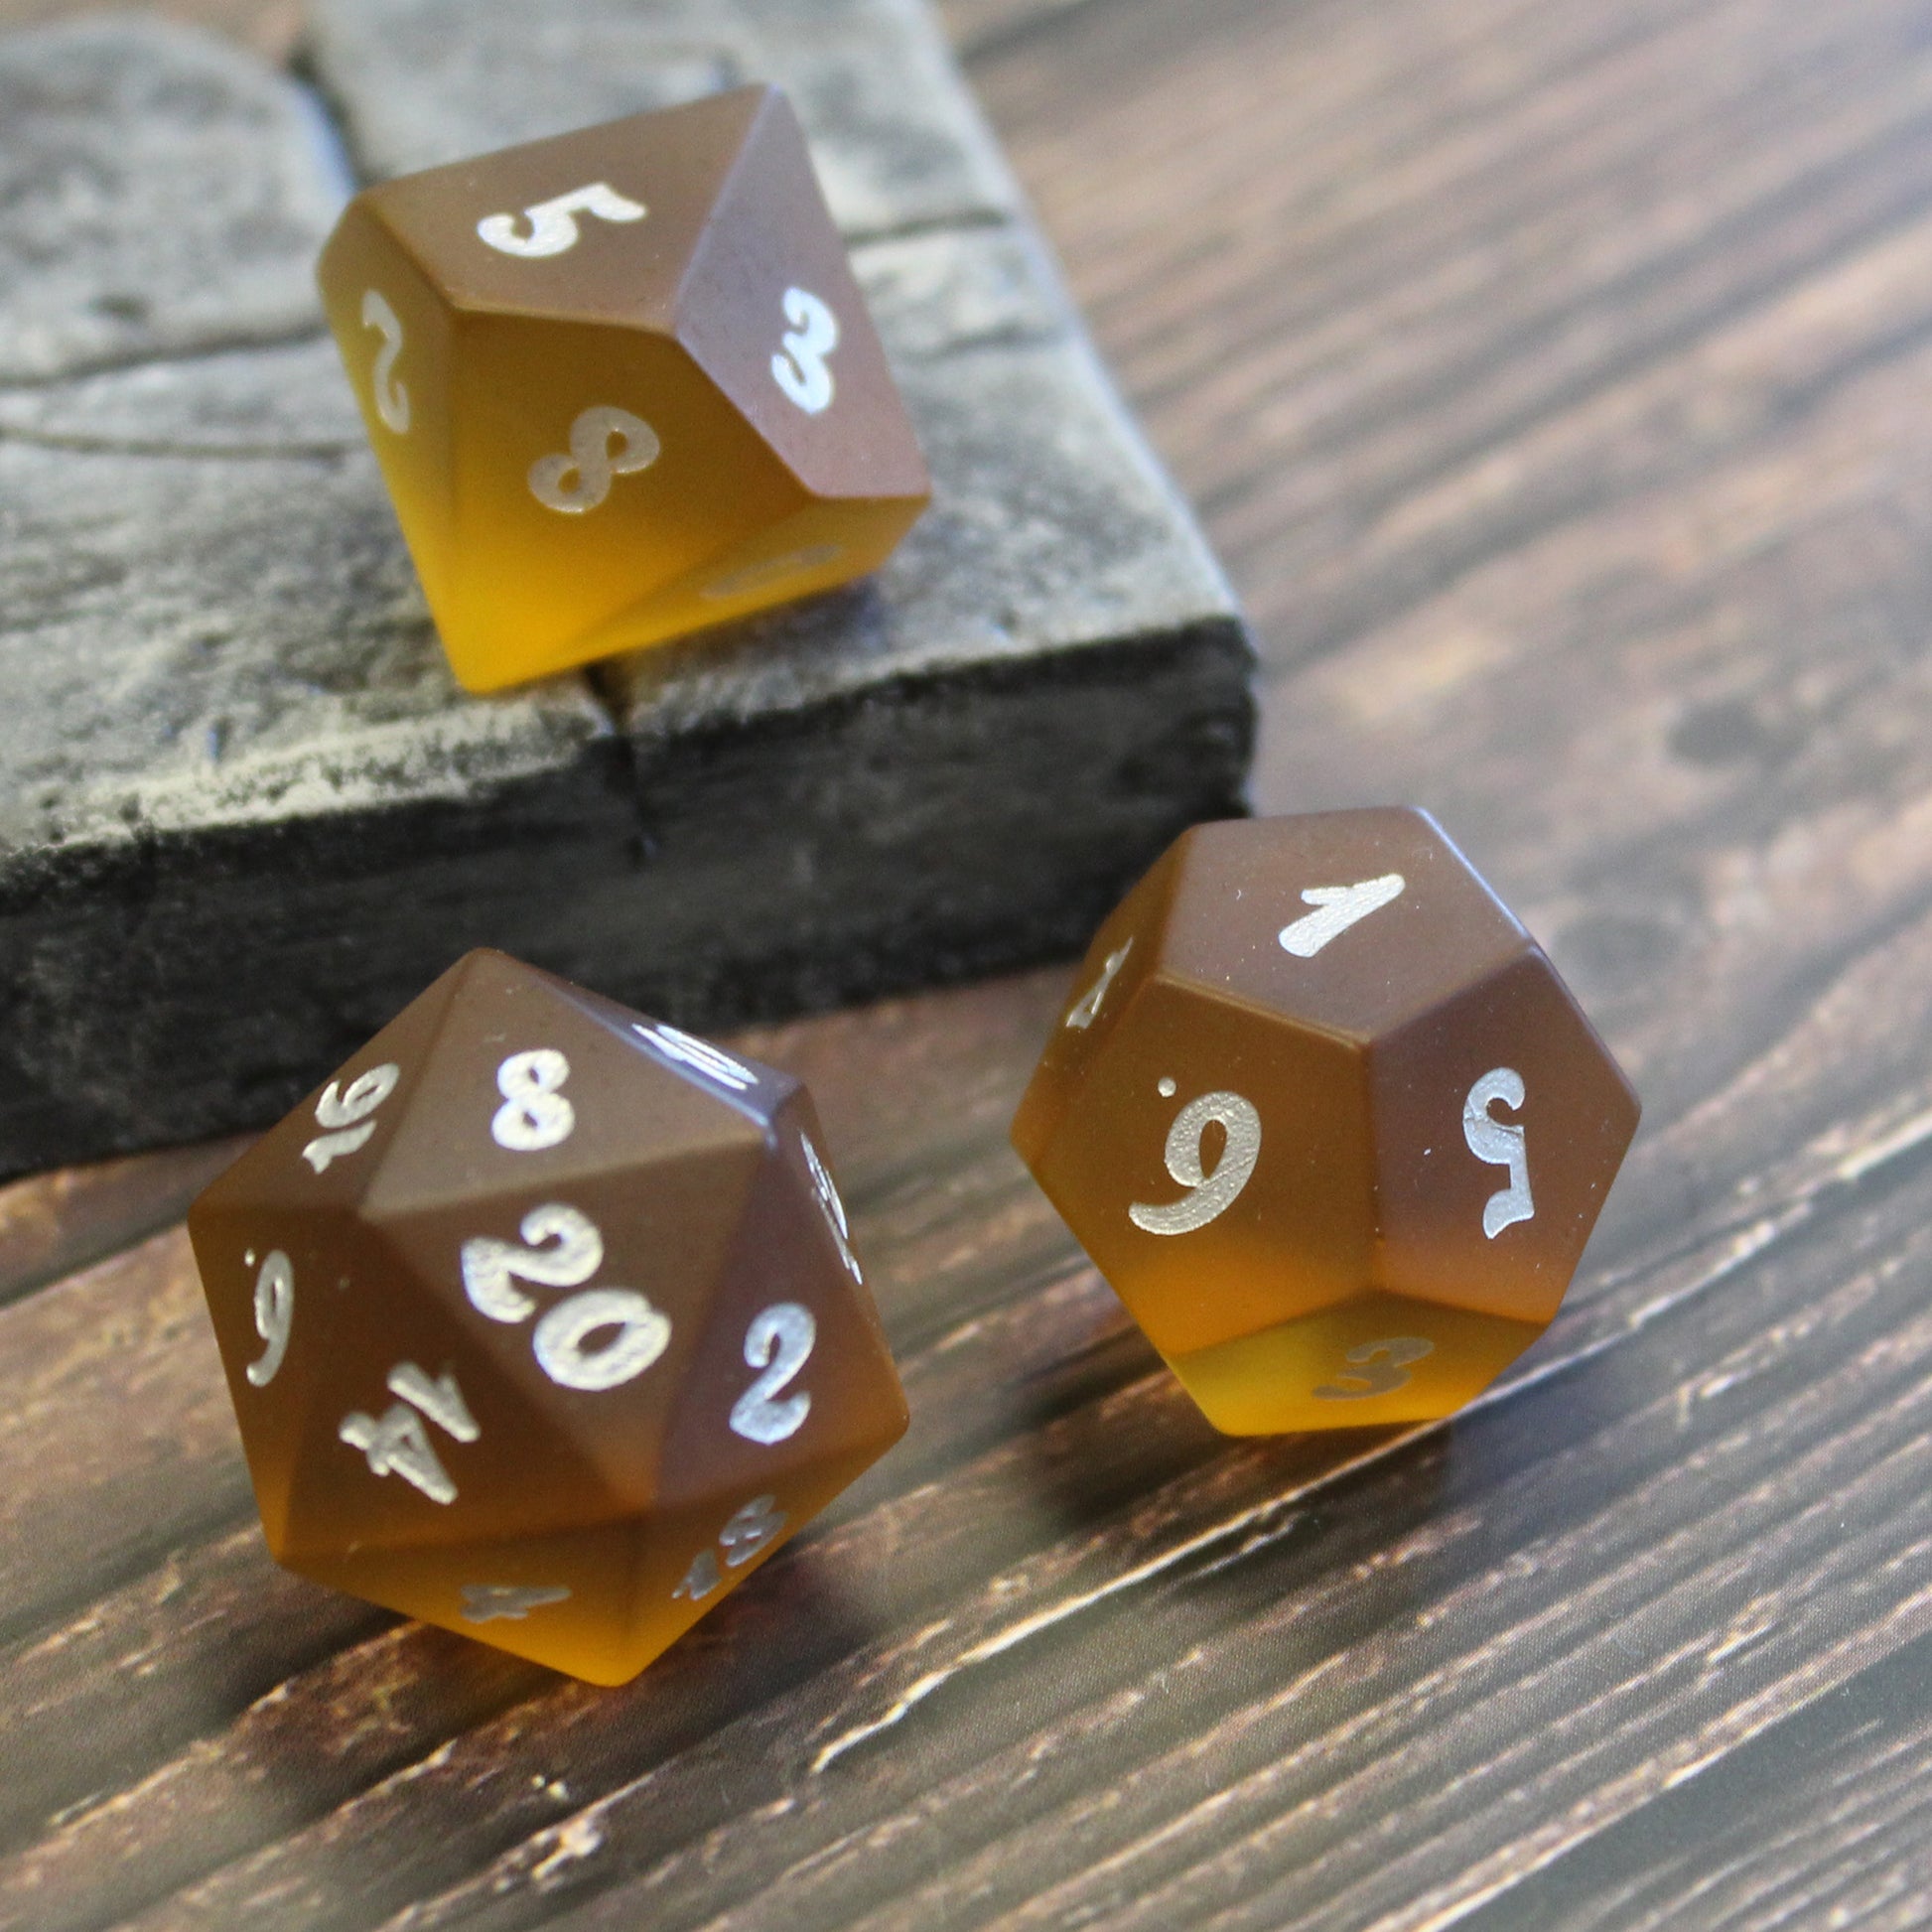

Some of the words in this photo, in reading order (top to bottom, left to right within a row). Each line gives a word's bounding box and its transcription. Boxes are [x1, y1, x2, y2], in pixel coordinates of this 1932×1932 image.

[477, 182, 647, 257] 5
[771, 287, 840, 415] 3
[527, 405, 660, 514] 8
[1279, 873, 1406, 958] 1
[302, 1062, 400, 1174] 16
[491, 1048, 575, 1152] 8
[1462, 1066, 1536, 1240] 5
[461, 1202, 673, 1392] 20
[339, 1361, 481, 1505] 14
[729, 1302, 817, 1446] 2
